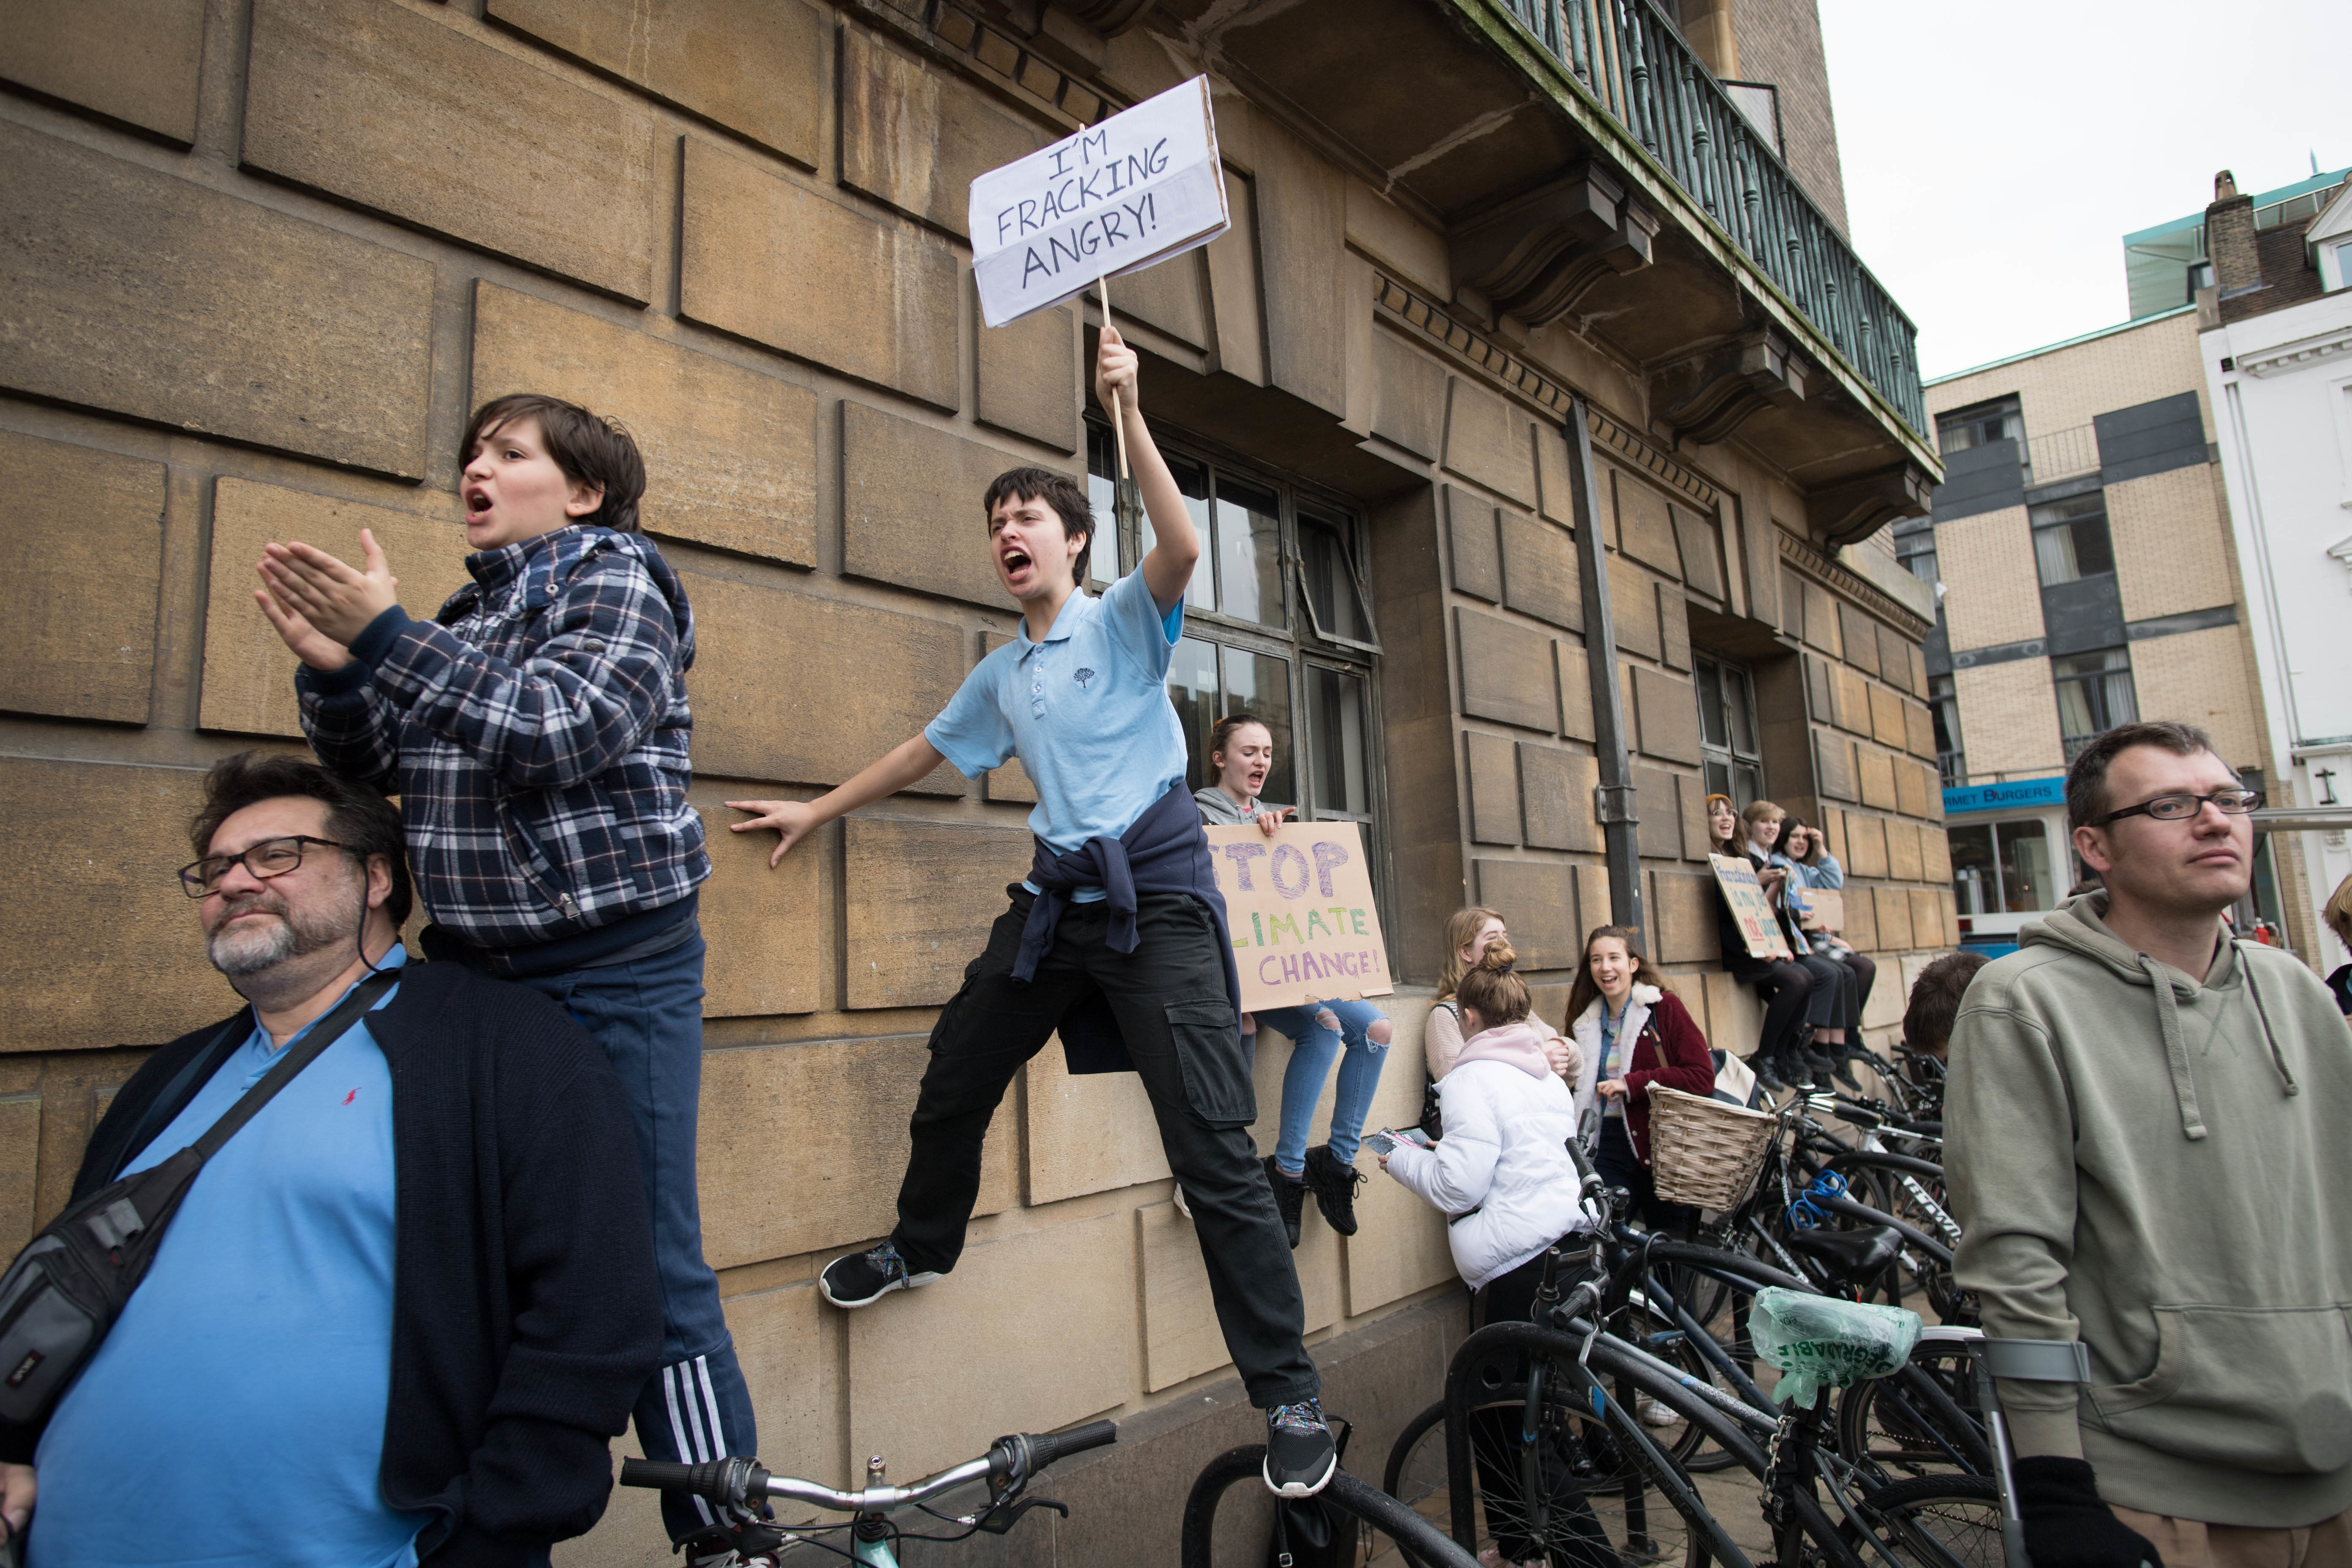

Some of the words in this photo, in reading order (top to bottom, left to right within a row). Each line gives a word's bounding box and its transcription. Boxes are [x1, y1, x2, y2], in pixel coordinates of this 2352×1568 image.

[1048, 129, 1107, 180] I'M
[998, 137, 1169, 246] FRACKING
[1023, 193, 1156, 289] ANGRY!
[1730, 887, 1743, 907] is
[1740, 891, 1759, 917] my
[1743, 915, 1763, 938] not
[1758, 918, 1781, 949] yours
[1259, 949, 1380, 985] CHANGE!
[1621, 1432, 1693, 1516] TRANSFER
